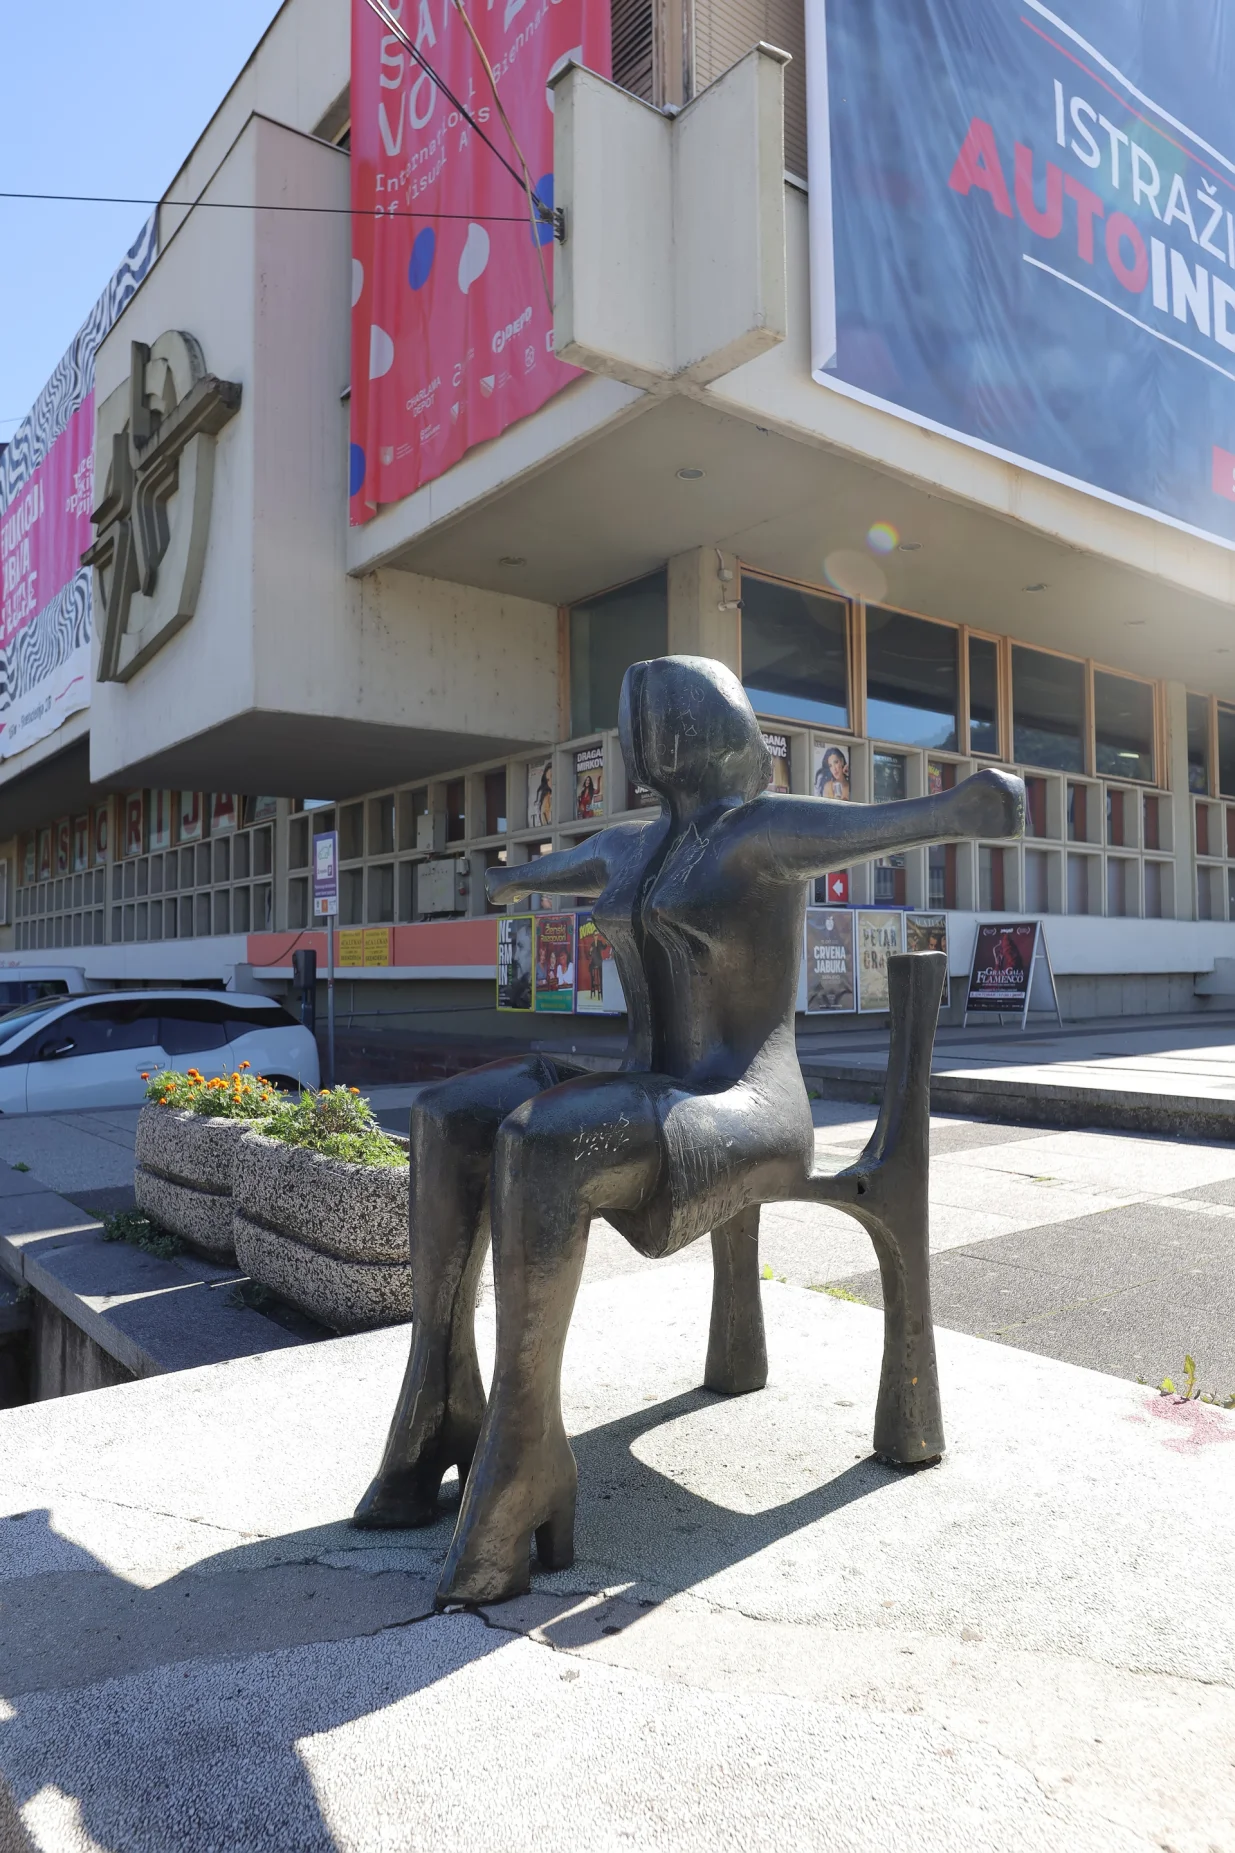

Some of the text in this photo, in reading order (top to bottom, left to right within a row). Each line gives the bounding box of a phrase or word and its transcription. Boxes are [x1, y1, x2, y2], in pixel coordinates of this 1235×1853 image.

[491, 0, 563, 85] Biennal
[577, 747, 603, 763] DRAGA
[813, 945, 846, 960] CRVENA
[813, 960, 847, 974] JABUKA
[976, 970, 1024, 984] FLAMENCO
